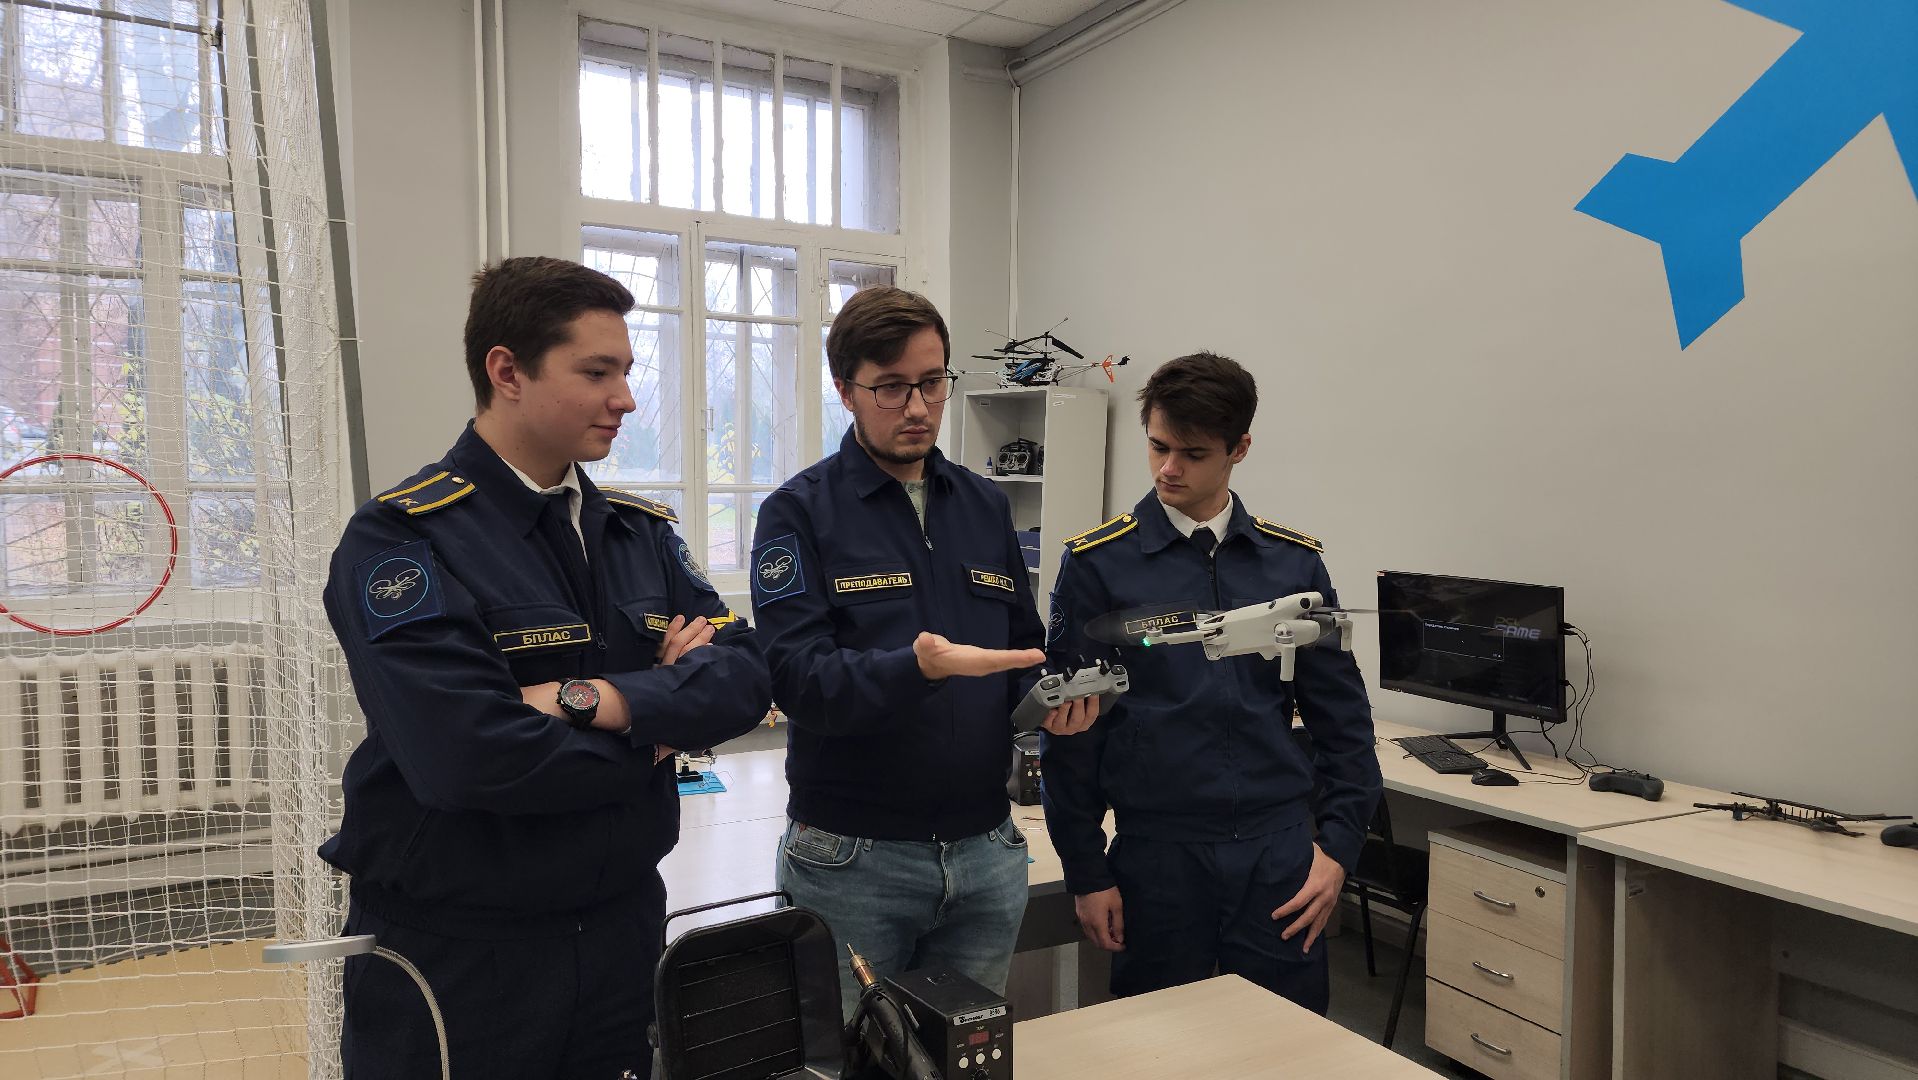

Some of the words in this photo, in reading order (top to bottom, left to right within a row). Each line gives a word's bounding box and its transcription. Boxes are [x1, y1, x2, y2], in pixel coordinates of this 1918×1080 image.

[840, 576, 909, 589] ПРЕПОДАВАТЕЛЬ
[1141, 615, 1179, 629] БПЛАС
[522, 630, 571, 645] БПЛАС
